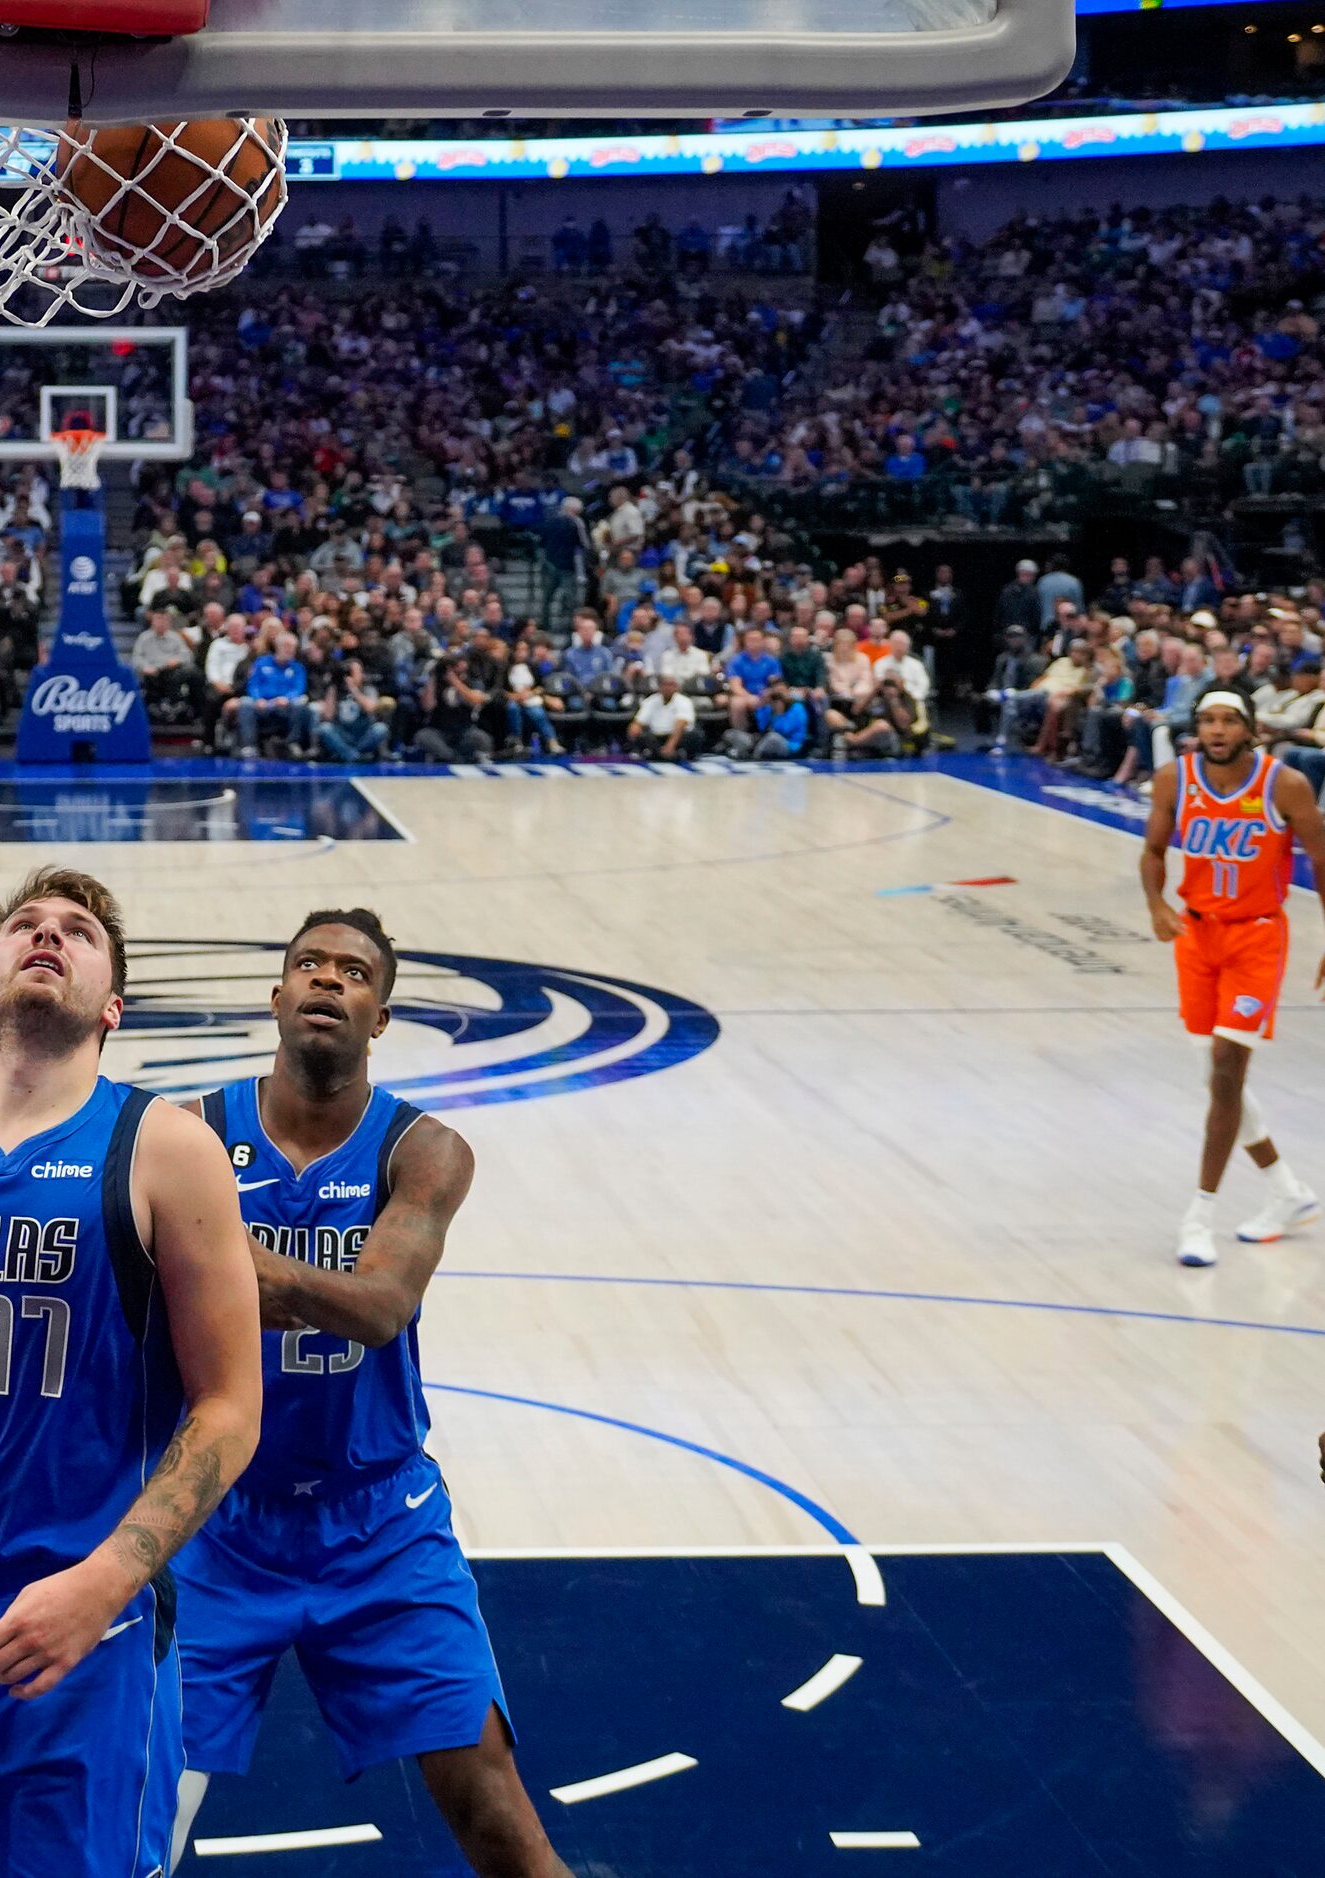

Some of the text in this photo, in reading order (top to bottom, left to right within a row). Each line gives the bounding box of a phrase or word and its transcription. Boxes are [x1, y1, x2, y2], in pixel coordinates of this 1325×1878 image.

[31, 675, 136, 725] Bally
[53, 714, 112, 733] SPORTS
[1184, 816, 1267, 862] OKC
[1211, 861, 1238, 898] 11
[232, 1145, 251, 1167] 6
[31, 1160, 93, 1179] chime
[319, 1181, 371, 1199] chime
